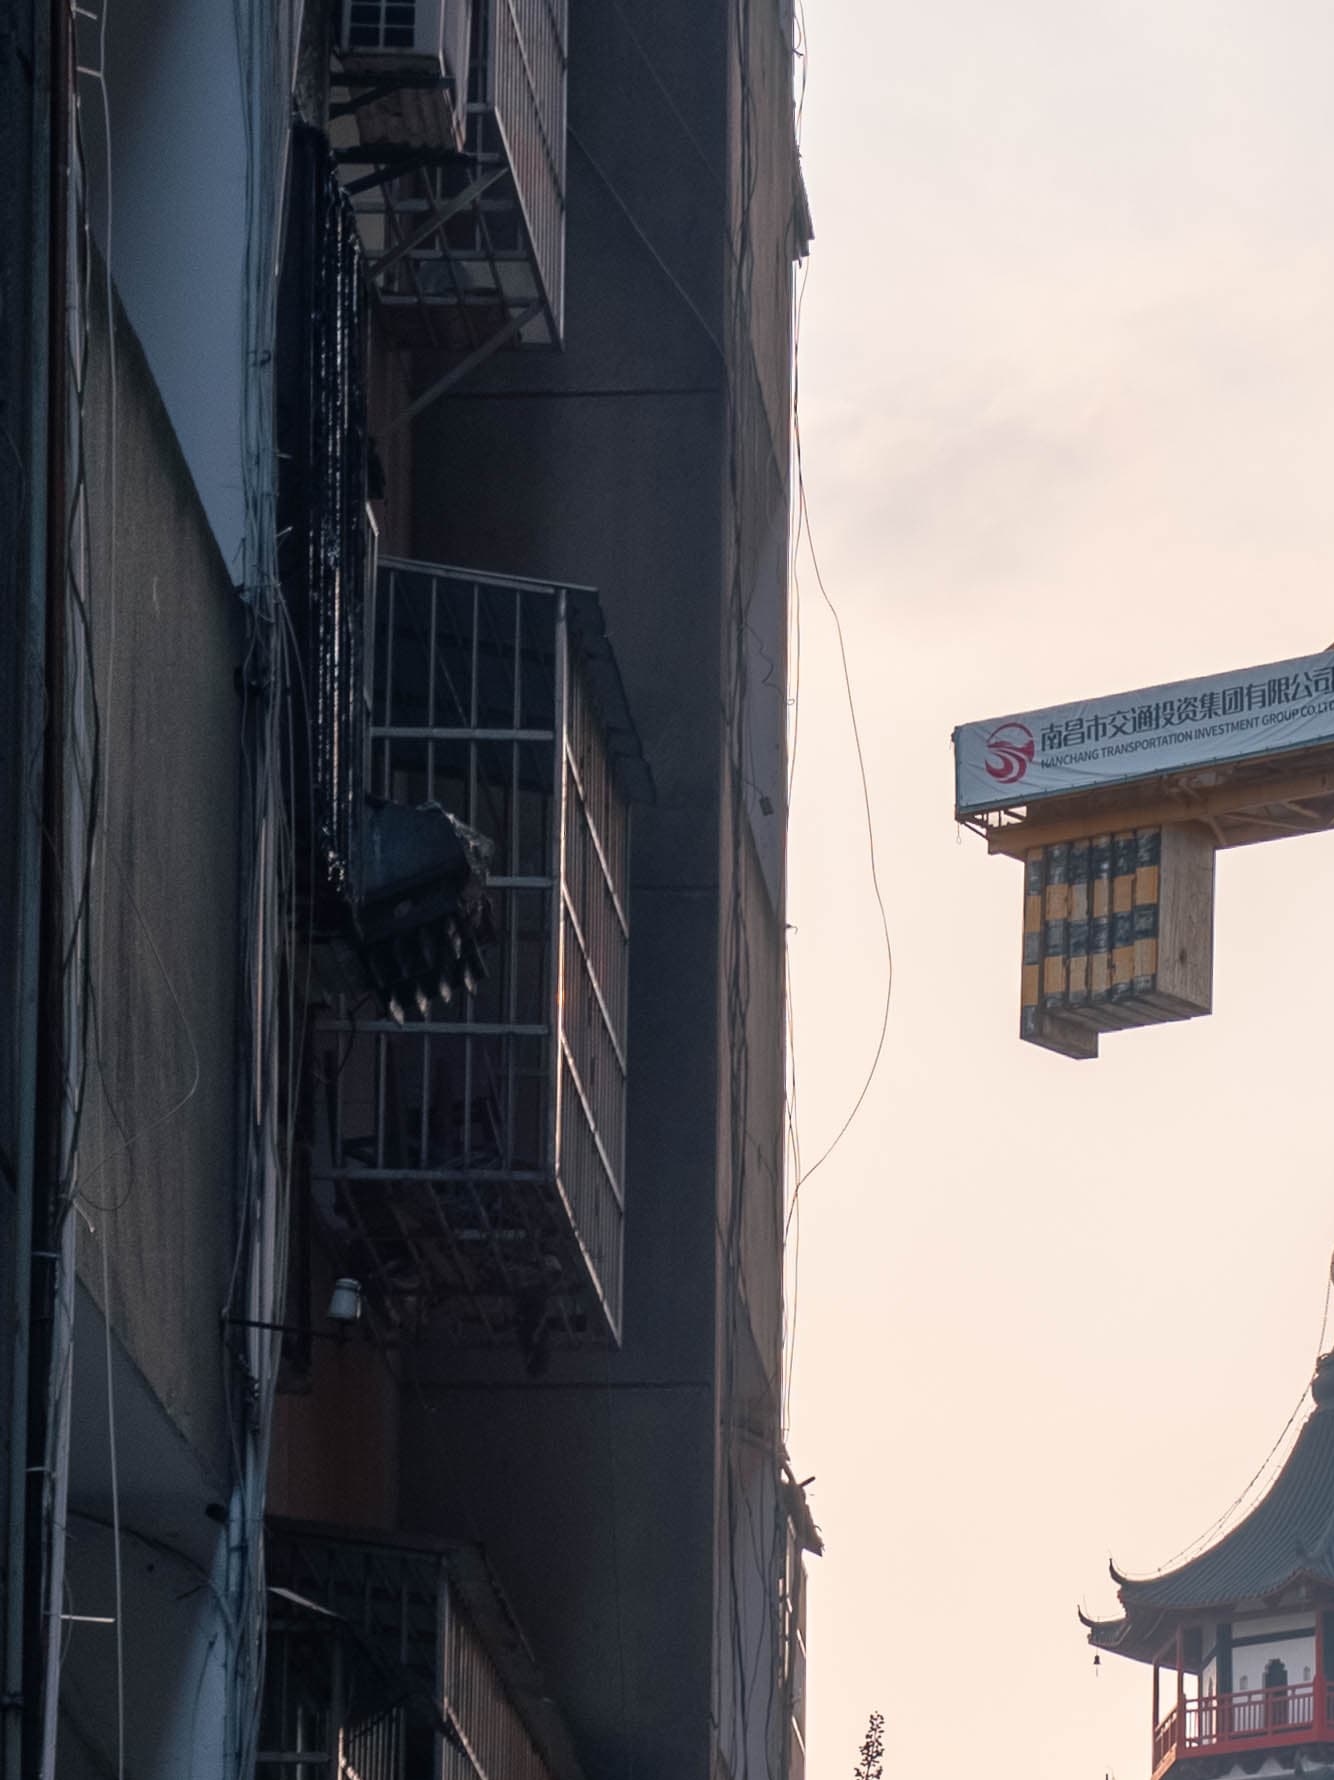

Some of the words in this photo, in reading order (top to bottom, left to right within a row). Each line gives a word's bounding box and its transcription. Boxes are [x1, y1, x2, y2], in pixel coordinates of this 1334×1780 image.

[1041, 749, 1100, 769] NANCHANG
[1102, 730, 1193, 758] TRANSPORTATION
[1195, 717, 1260, 739] INVESTMENT
[1262, 709, 1299, 726] GROUP
